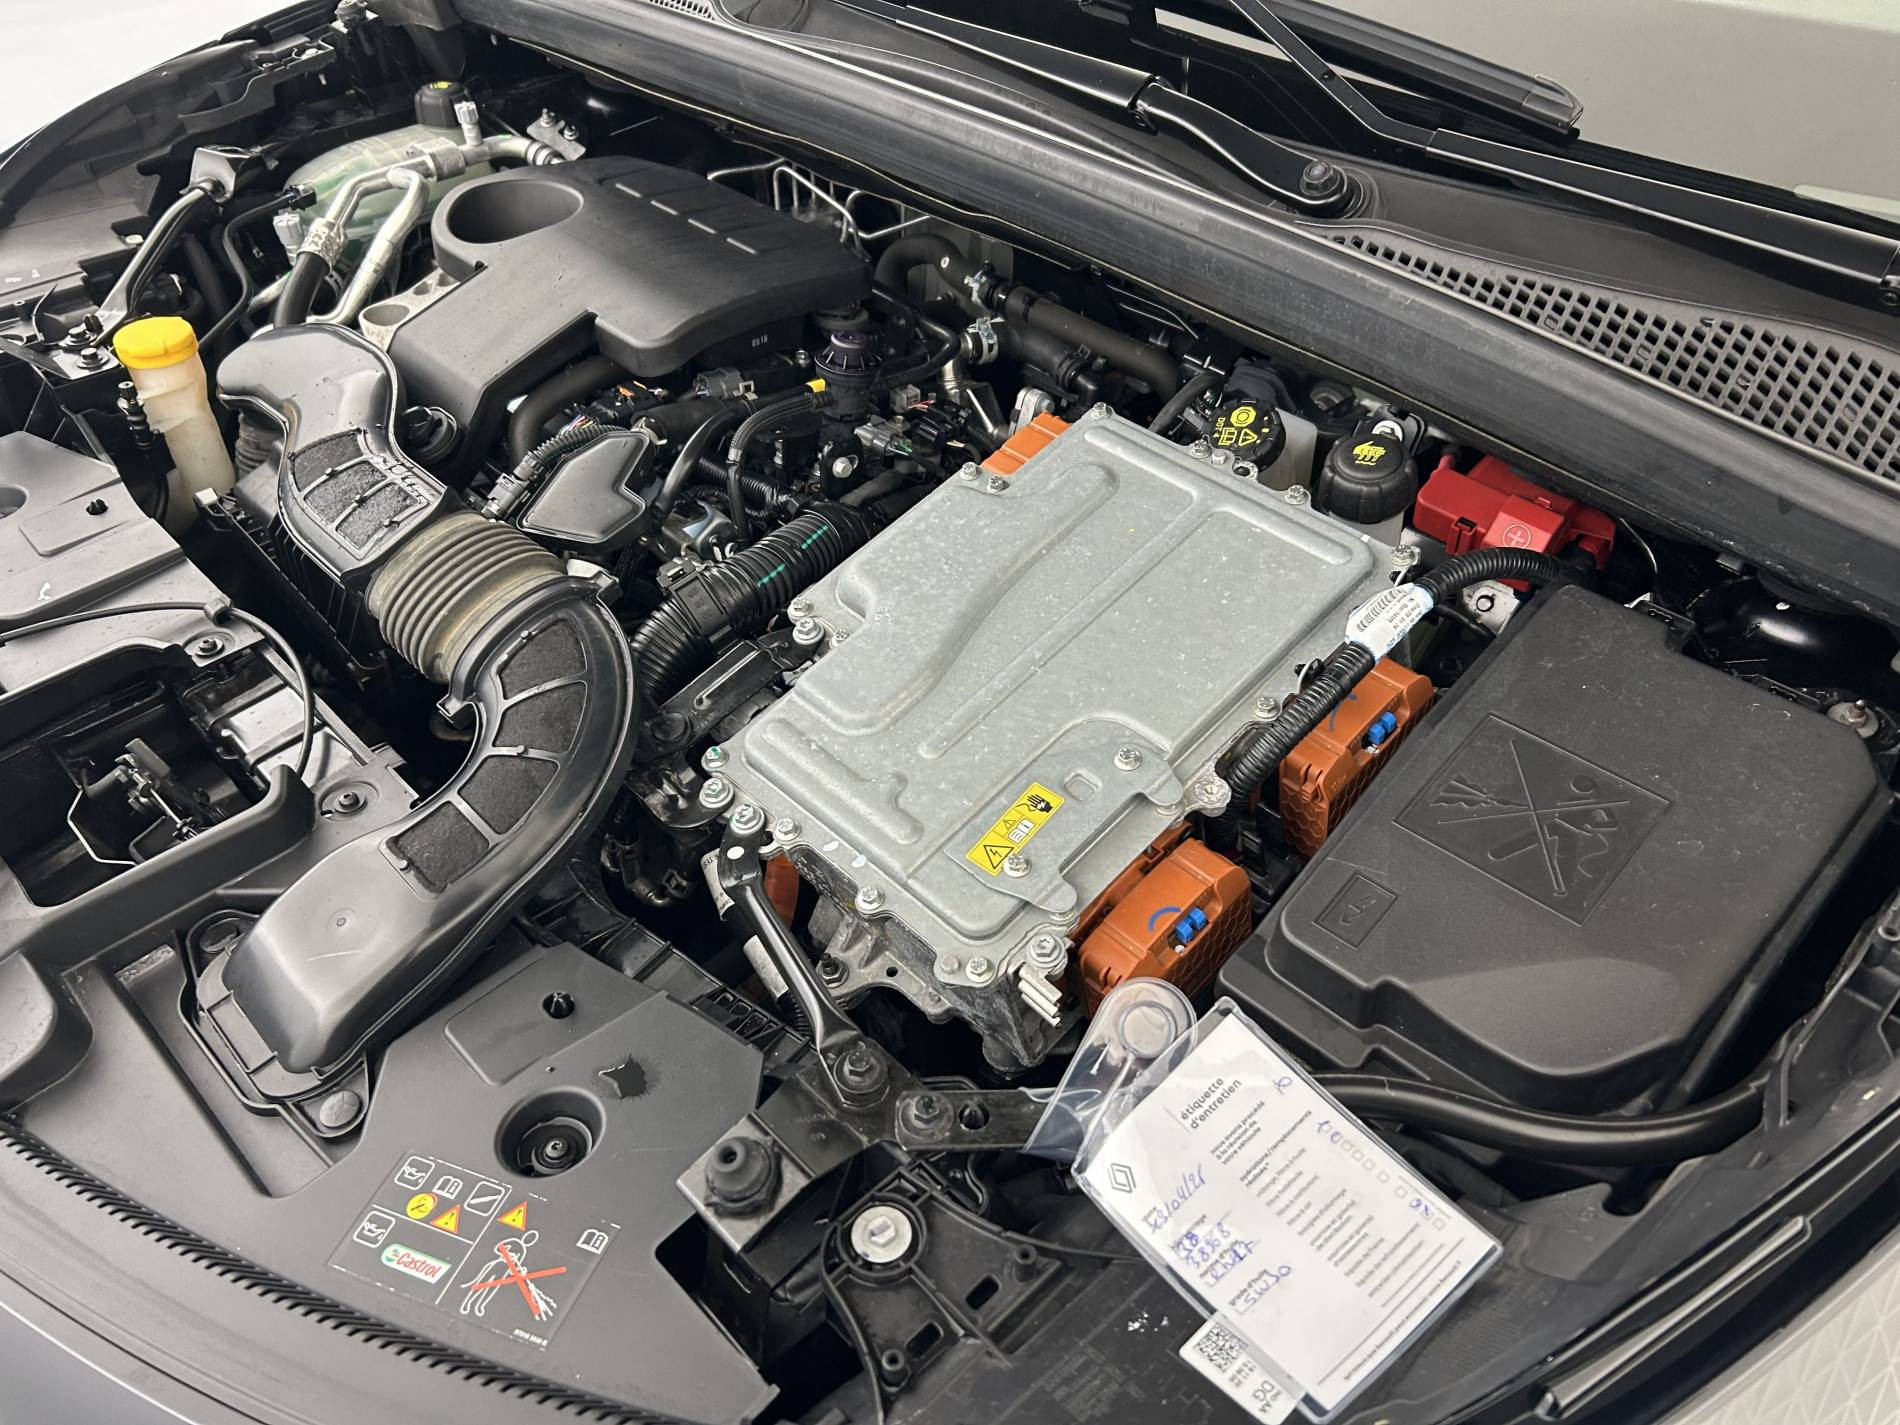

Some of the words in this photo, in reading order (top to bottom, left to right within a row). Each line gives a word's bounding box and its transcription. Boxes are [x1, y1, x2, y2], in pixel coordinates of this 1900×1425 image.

[1181, 1078, 1224, 1120] étiquette
[1190, 1080, 1242, 1129] d'entretien
[396, 1251, 443, 1279] Castrol
[1252, 1380, 1275, 1402] DG
